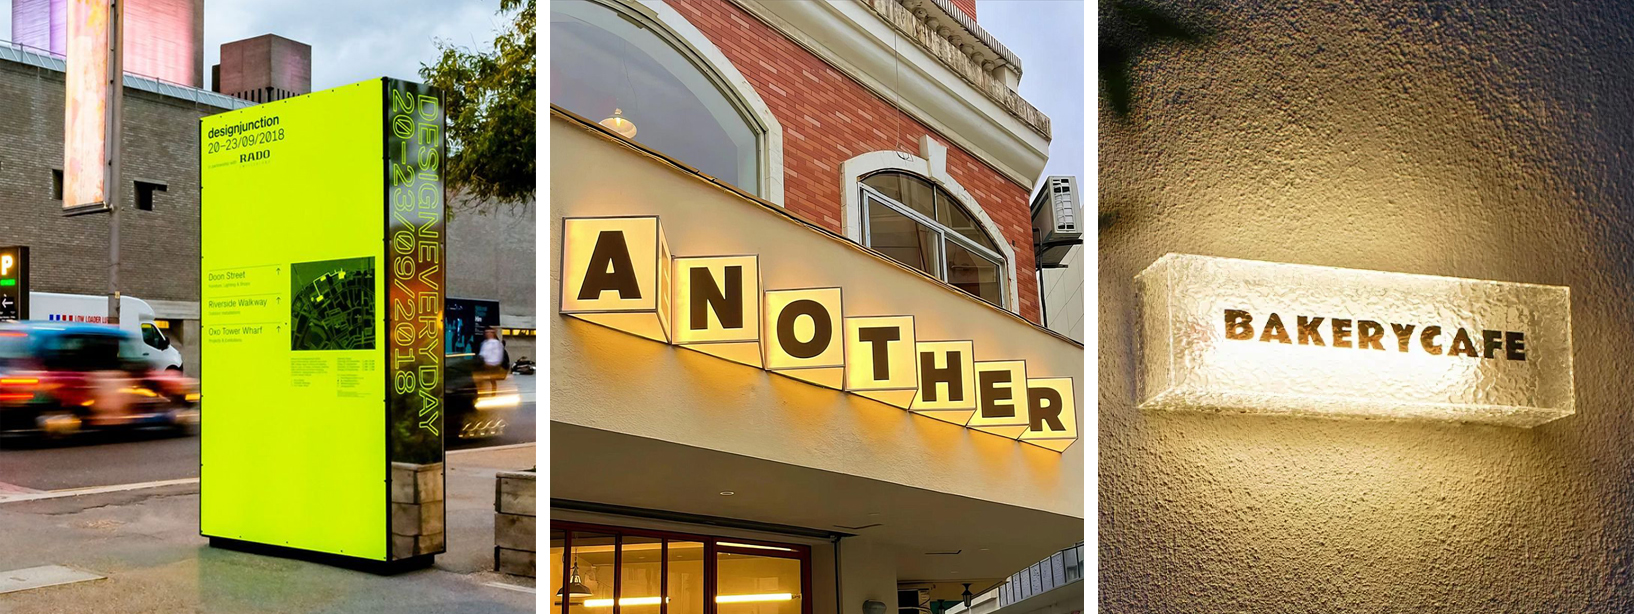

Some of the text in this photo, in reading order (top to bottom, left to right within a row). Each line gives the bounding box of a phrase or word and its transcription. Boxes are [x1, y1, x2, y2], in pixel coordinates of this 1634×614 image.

[208, 115, 280, 139] designjunction
[208, 128, 285, 154] 20-23/09/2018
[240, 149, 270, 163] RADO
[392, 88, 416, 395] 20-23/09/2018
[1, 255, 13, 276] P
[208, 271, 246, 281] Doon Street
[418, 94, 439, 436] DESIGNEVERYDAY
[208, 298, 268, 308] Riverside Walkway
[208, 326, 263, 336] Oxo Tower Wharf
[577, 230, 1065, 432] ANOTHER
[1224, 308, 1526, 361] BAKERYCAFE
